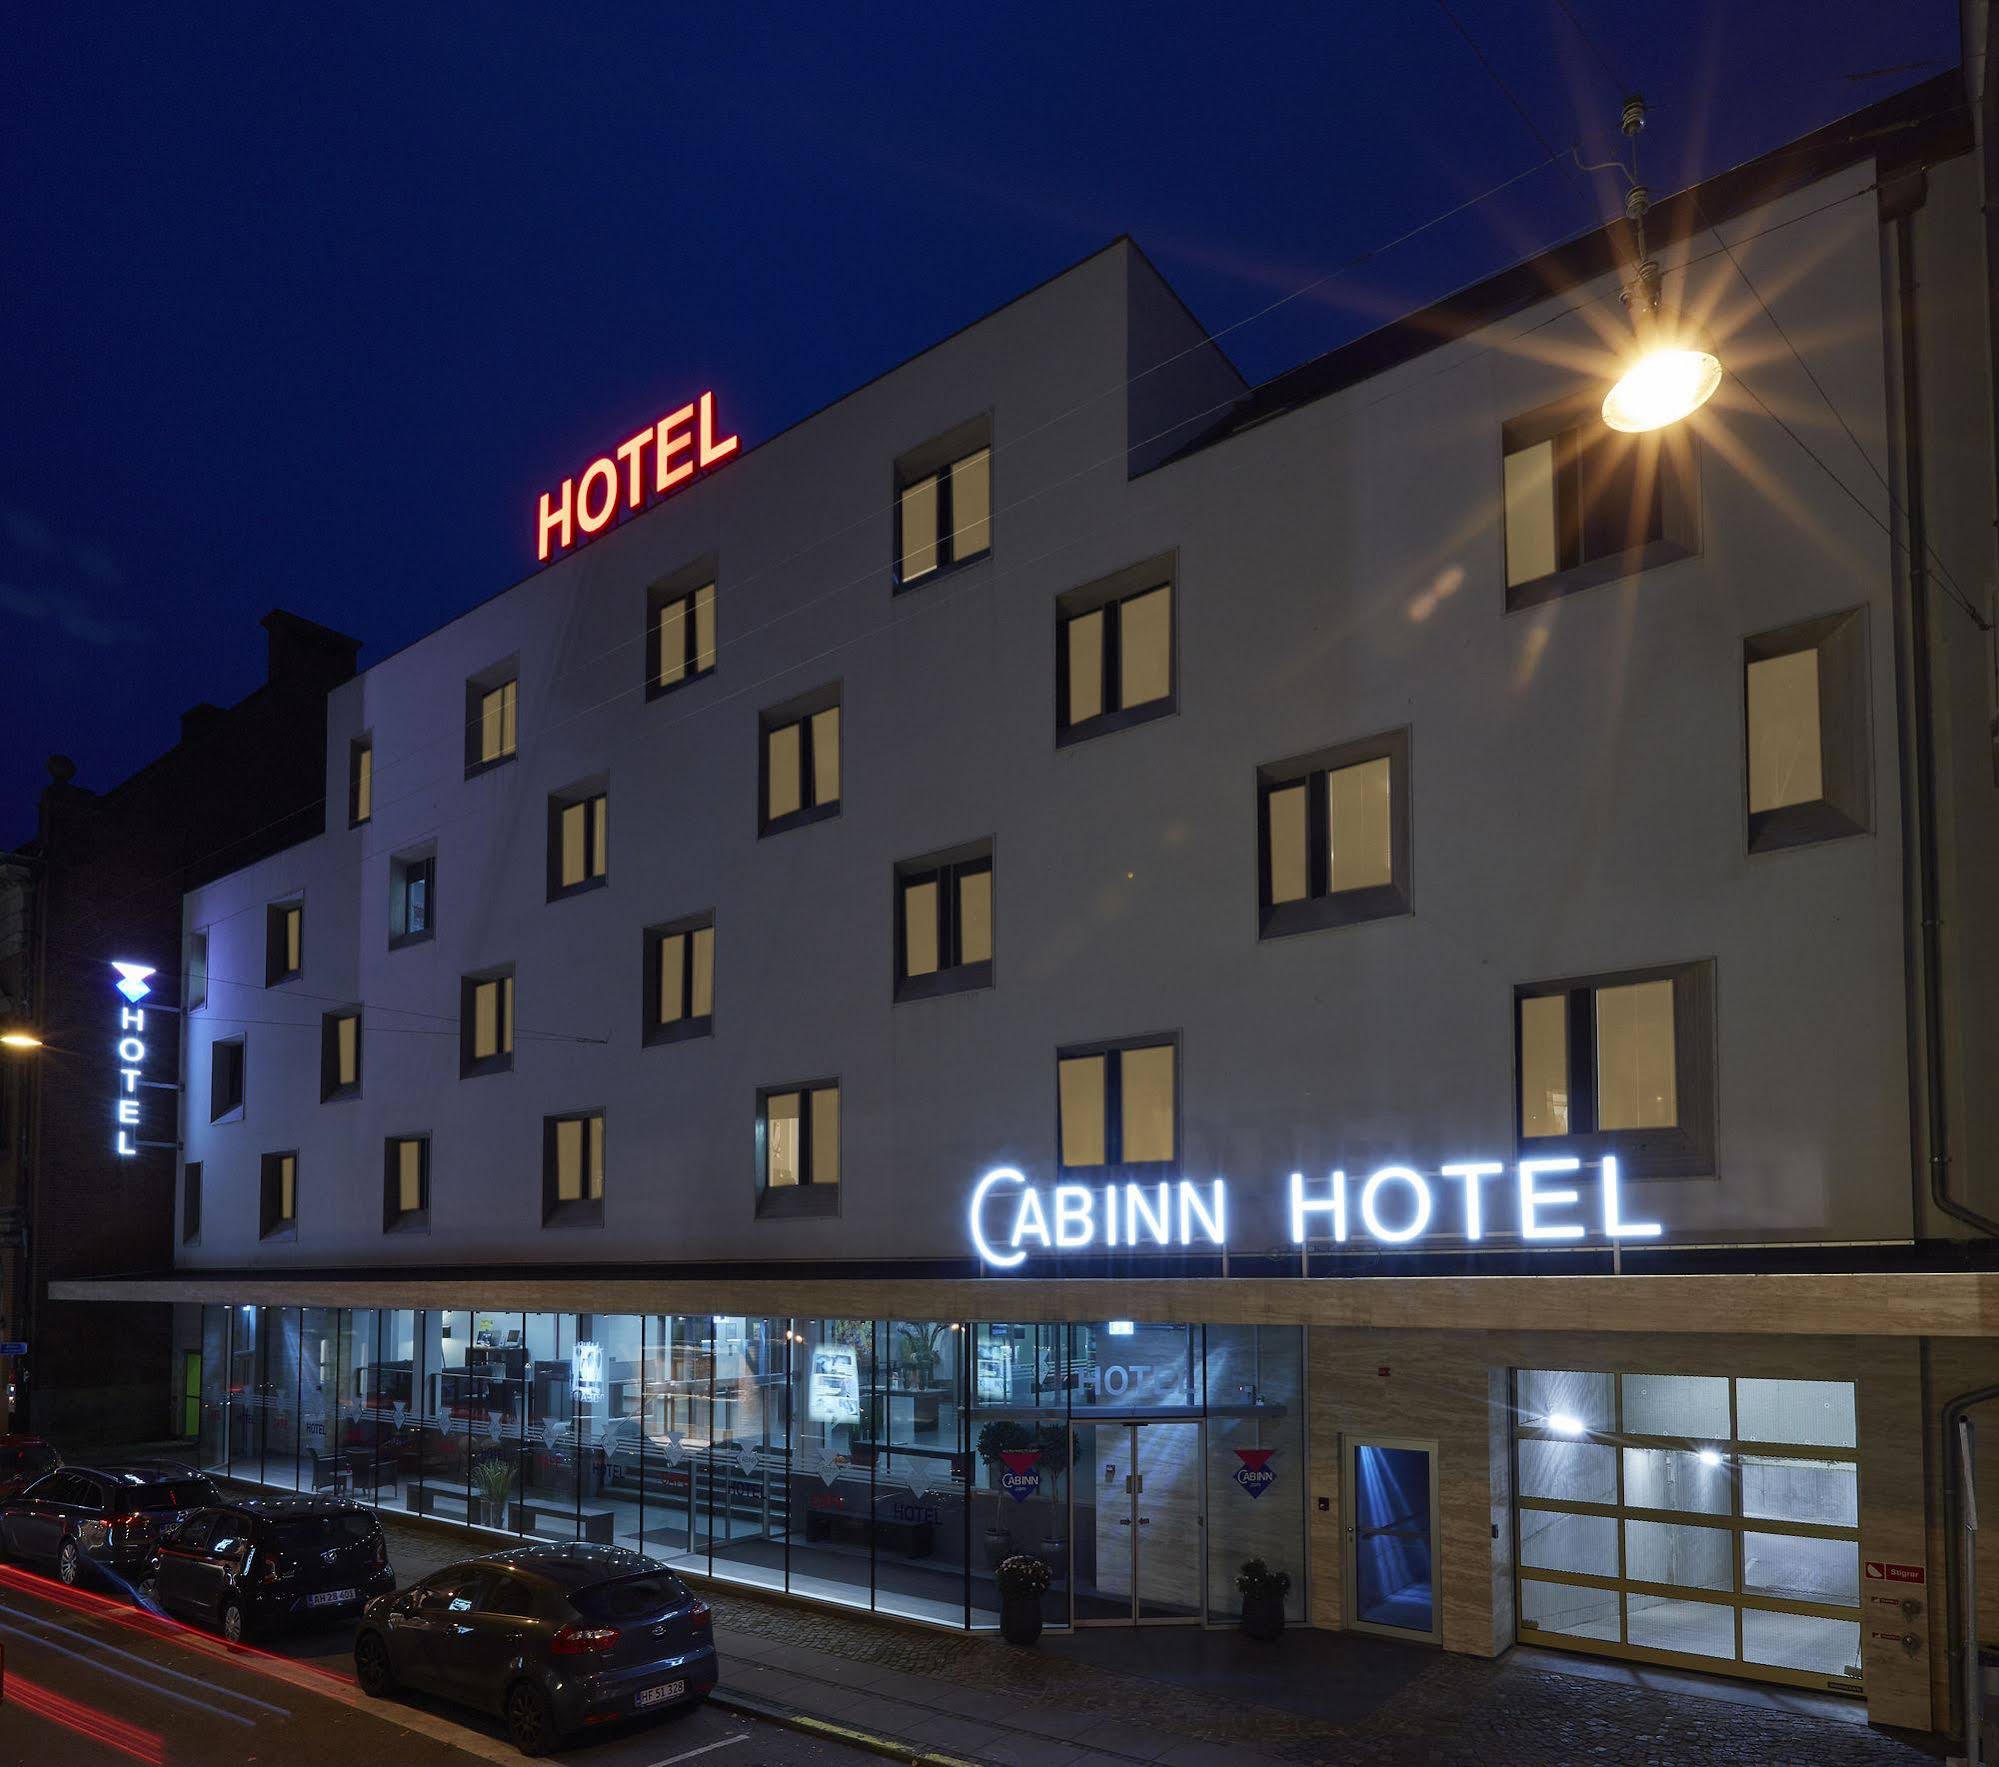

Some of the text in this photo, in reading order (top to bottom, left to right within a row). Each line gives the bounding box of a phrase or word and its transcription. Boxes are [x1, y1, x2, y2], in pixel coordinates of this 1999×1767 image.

[538, 391, 738, 562] HOTEL
[118, 1006, 145, 1155] HOTEL
[970, 1156, 1662, 1267] CABINN HOTEL
[306, 1422, 327, 1435] HOTEL
[1002, 1473, 1040, 1488] CABINN
[1237, 1469, 1273, 1484] CABINN
[727, 1482, 767, 1499] HOTEL
[894, 1503, 944, 1525] HOTEL
[641, 1691, 653, 1702] HF
[668, 1682, 684, 1695] 328
